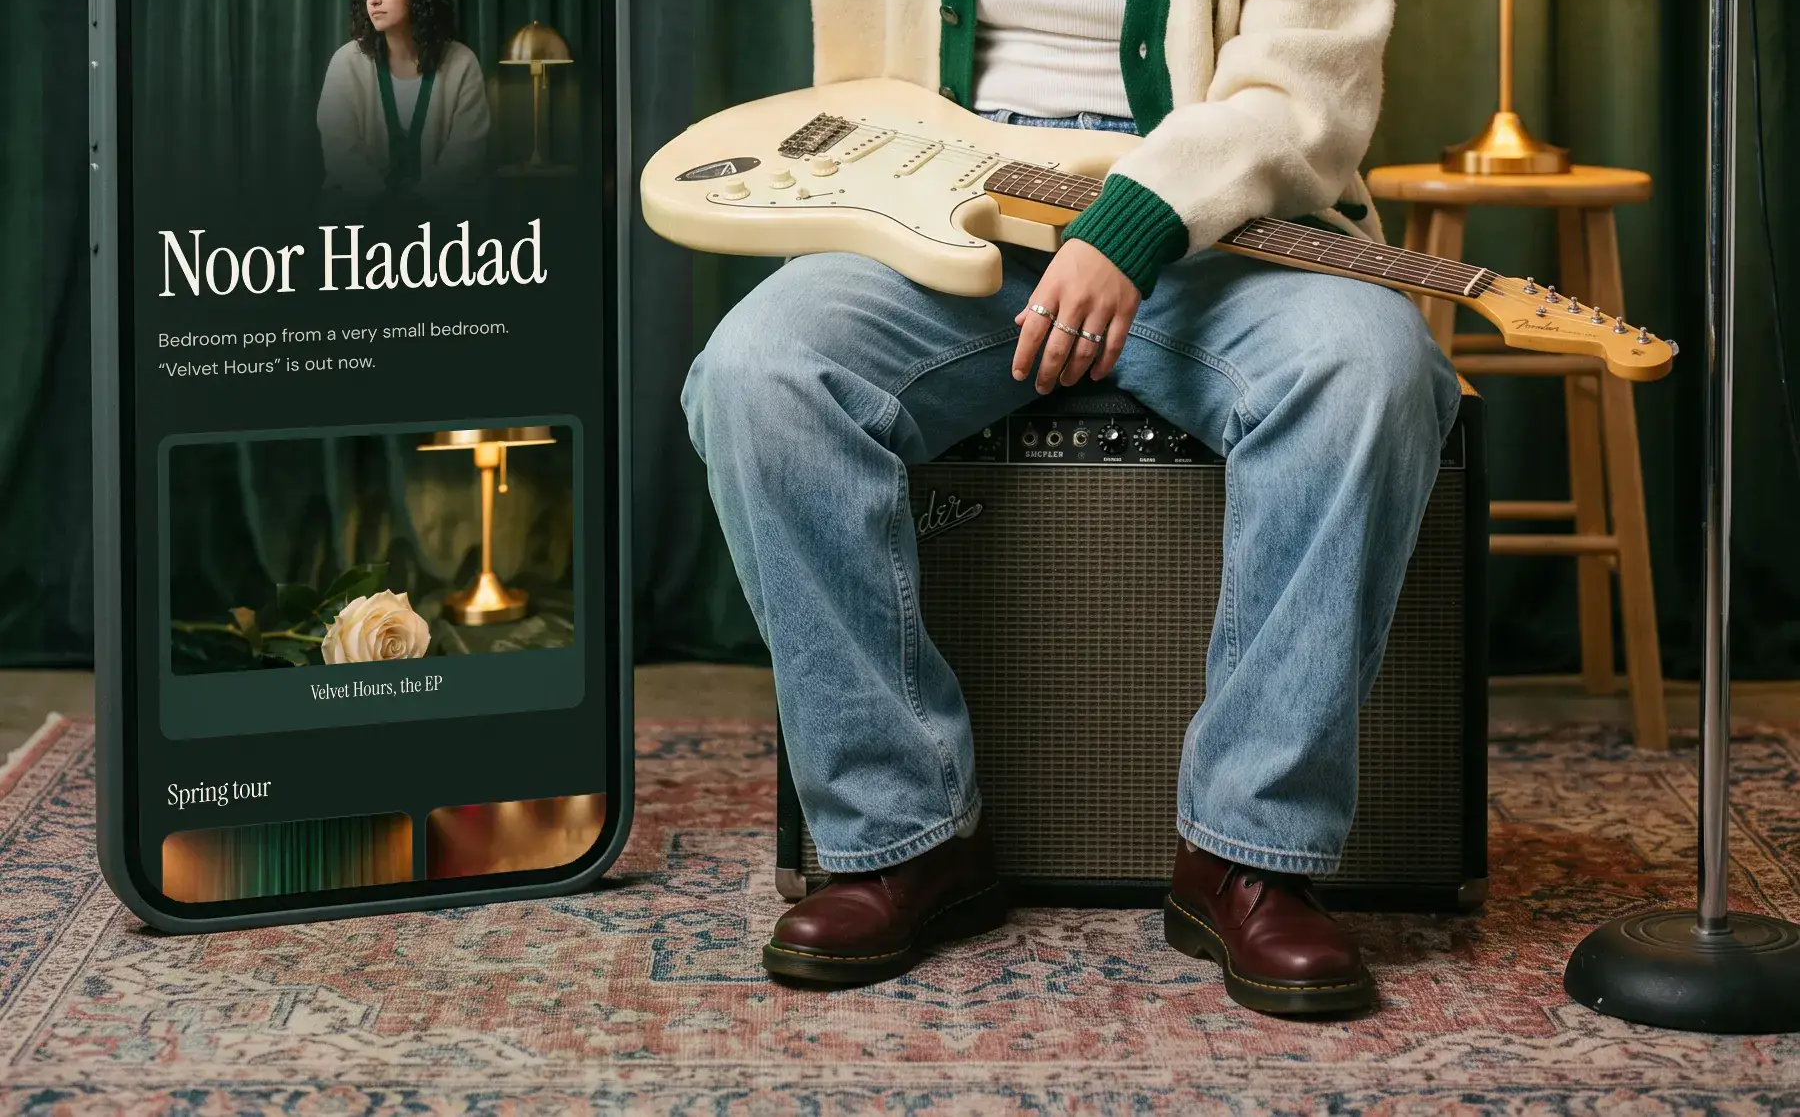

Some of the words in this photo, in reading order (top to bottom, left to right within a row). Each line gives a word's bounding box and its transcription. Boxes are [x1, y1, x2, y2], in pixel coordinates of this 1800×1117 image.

[158, 229, 305, 297] Noor
[318, 217, 548, 291] Haddad
[158, 332, 238, 348] Bedroom
[243, 332, 277, 349] pop
[281, 327, 322, 343] from
[326, 329, 337, 341] a
[341, 329, 378, 343] very
[382, 322, 425, 339] small
[430, 319, 510, 337] bedroom.
[158, 361, 219, 377] “Velvet
[224, 357, 281, 375] Hours”
[286, 357, 300, 372] is
[304, 356, 334, 371] out
[338, 356, 377, 370] now.
[917, 490, 983, 535] der
[310, 683, 350, 701] Velvet
[352, 679, 397, 698] Hours,
[400, 677, 422, 694] the
[424, 674, 443, 692] EP
[167, 781, 229, 810] Spring
[231, 779, 272, 800] tour
